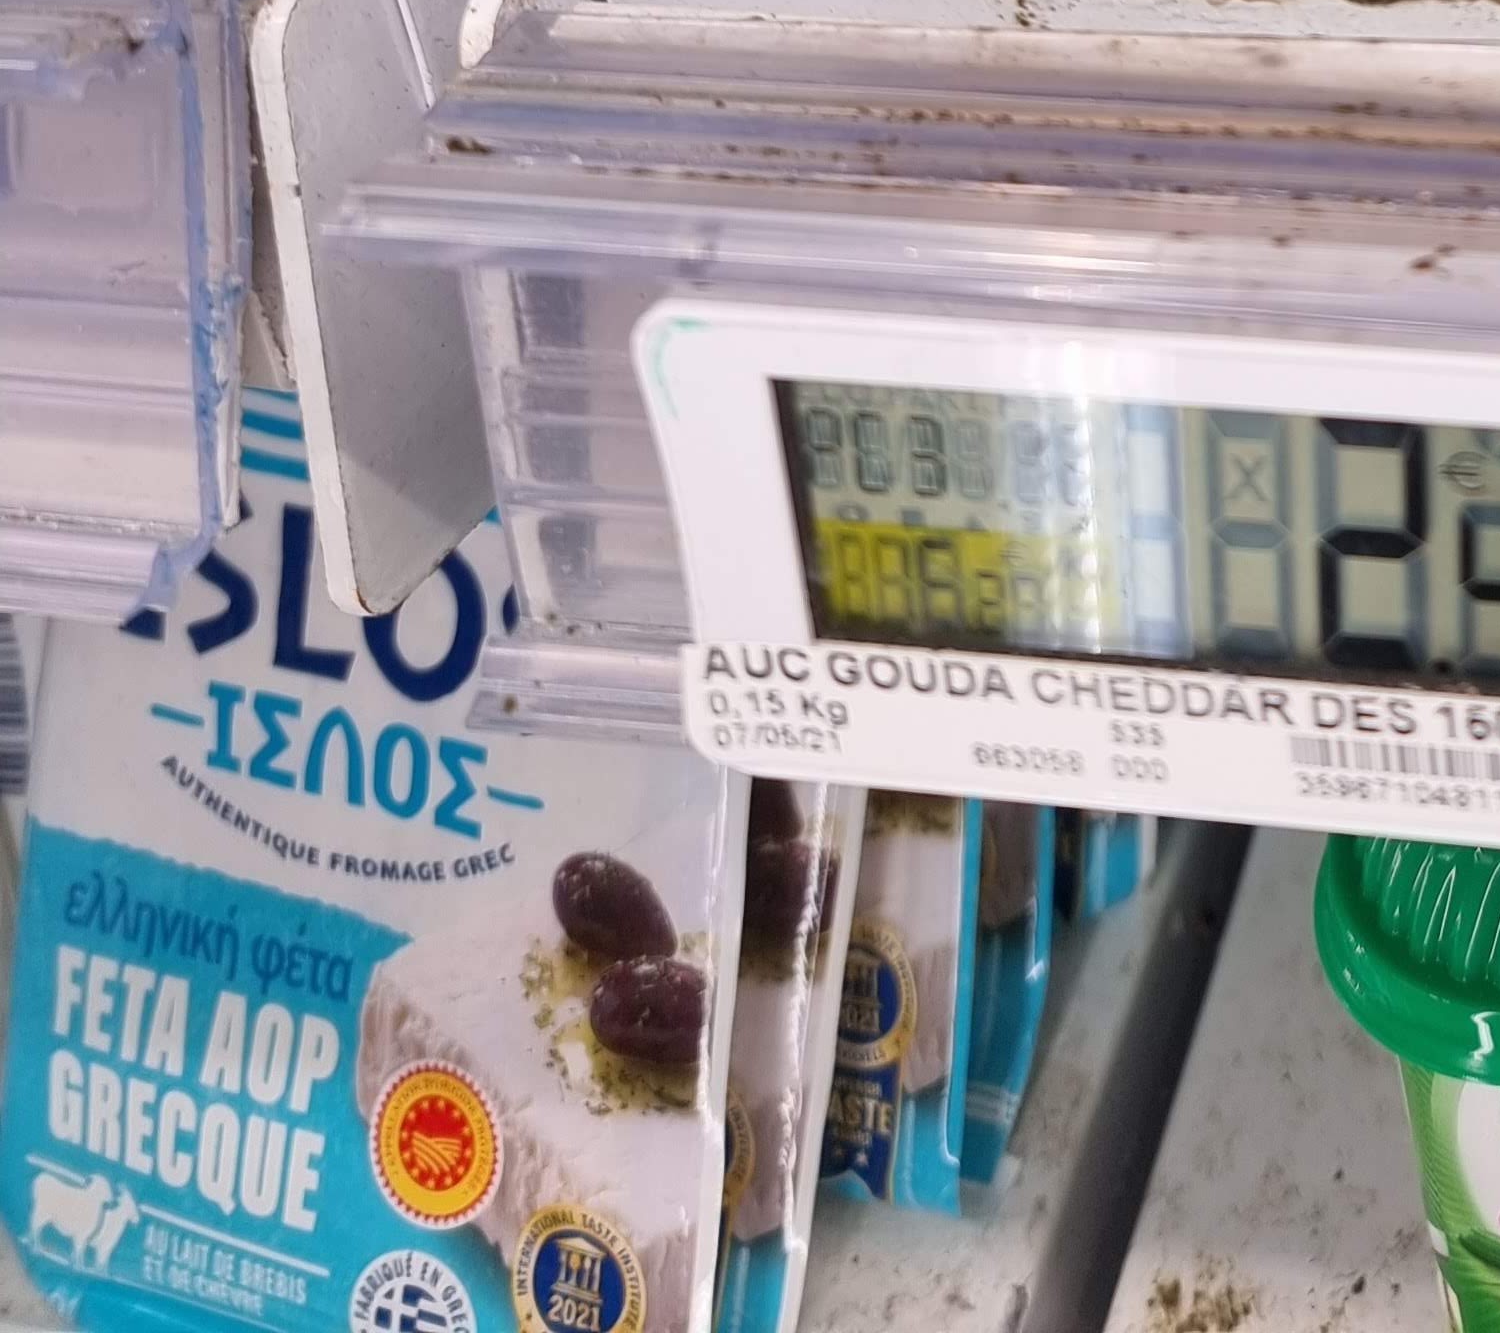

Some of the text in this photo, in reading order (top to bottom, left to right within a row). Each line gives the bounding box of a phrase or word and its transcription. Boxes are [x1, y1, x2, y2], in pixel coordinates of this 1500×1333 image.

[704, 645, 811, 682] AUC
[827, 650, 1015, 701] GOUDA
[1030, 668, 1295, 726] CHEDDAR
[1310, 692, 1418, 735] DES
[800, 692, 848, 727] Kg
[160, 754, 516, 882] AUTHENTIQUE FROMAGE GREC
[53, 944, 340, 1116] FETA AOP
[47, 1047, 325, 1233] GRECQUE
[171, 1234, 211, 1271] LAIT
[239, 1258, 307, 1306] BREBIS
[517, 1209, 576, 1297] INTERNATIONAL
[582, 1213, 619, 1248] TASTE
[548, 1293, 601, 1332] 2021
